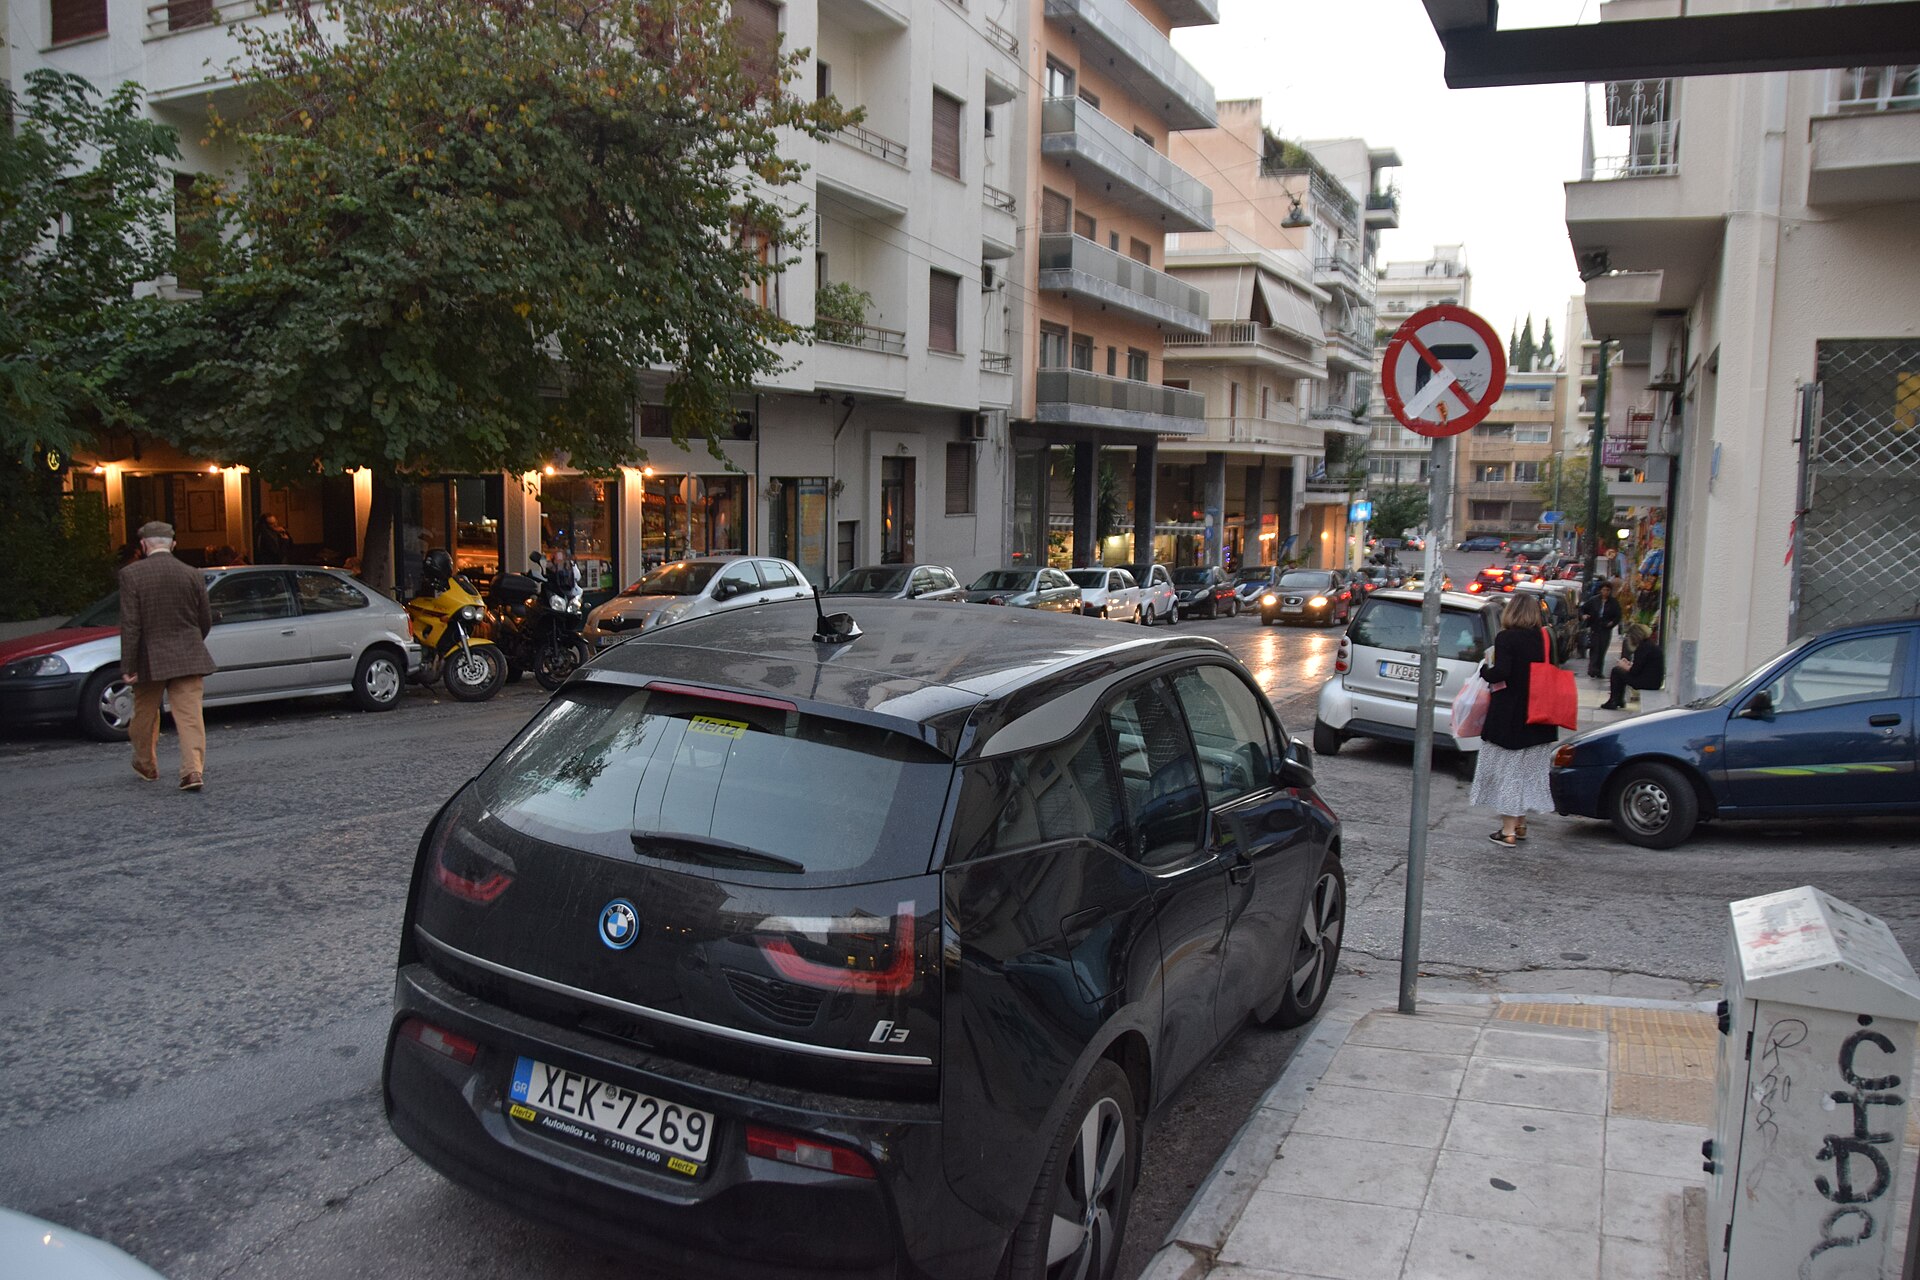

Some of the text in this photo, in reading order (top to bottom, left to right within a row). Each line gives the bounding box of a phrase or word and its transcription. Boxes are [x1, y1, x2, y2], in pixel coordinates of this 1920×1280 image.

[692, 718, 741, 736] Hertz
[869, 1019, 910, 1043] i3
[513, 1080, 528, 1095] GR
[513, 1105, 533, 1119] Hertz
[538, 1064, 706, 1152] XEK-7269
[542, 1116, 583, 1137] Autohellas
[671, 1158, 694, 1173] Hertz
